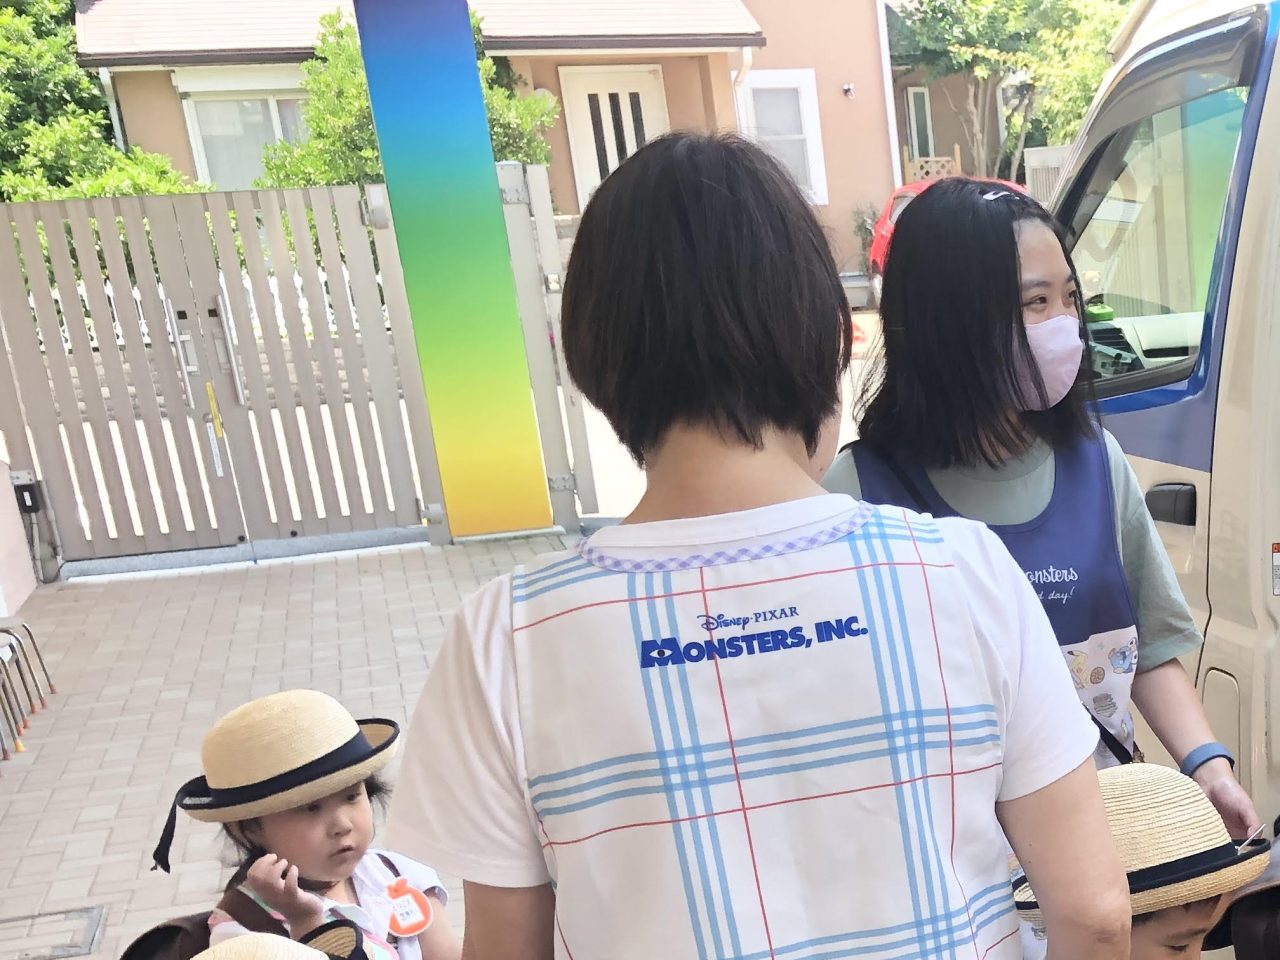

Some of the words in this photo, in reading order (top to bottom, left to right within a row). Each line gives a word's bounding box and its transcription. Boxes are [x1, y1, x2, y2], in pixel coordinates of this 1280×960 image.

[1025, 565, 1079, 584] onsters
[753, 606, 799, 623] PIXAR
[640, 626, 813, 669] MONSTERS,
[814, 616, 869, 643] INC.
